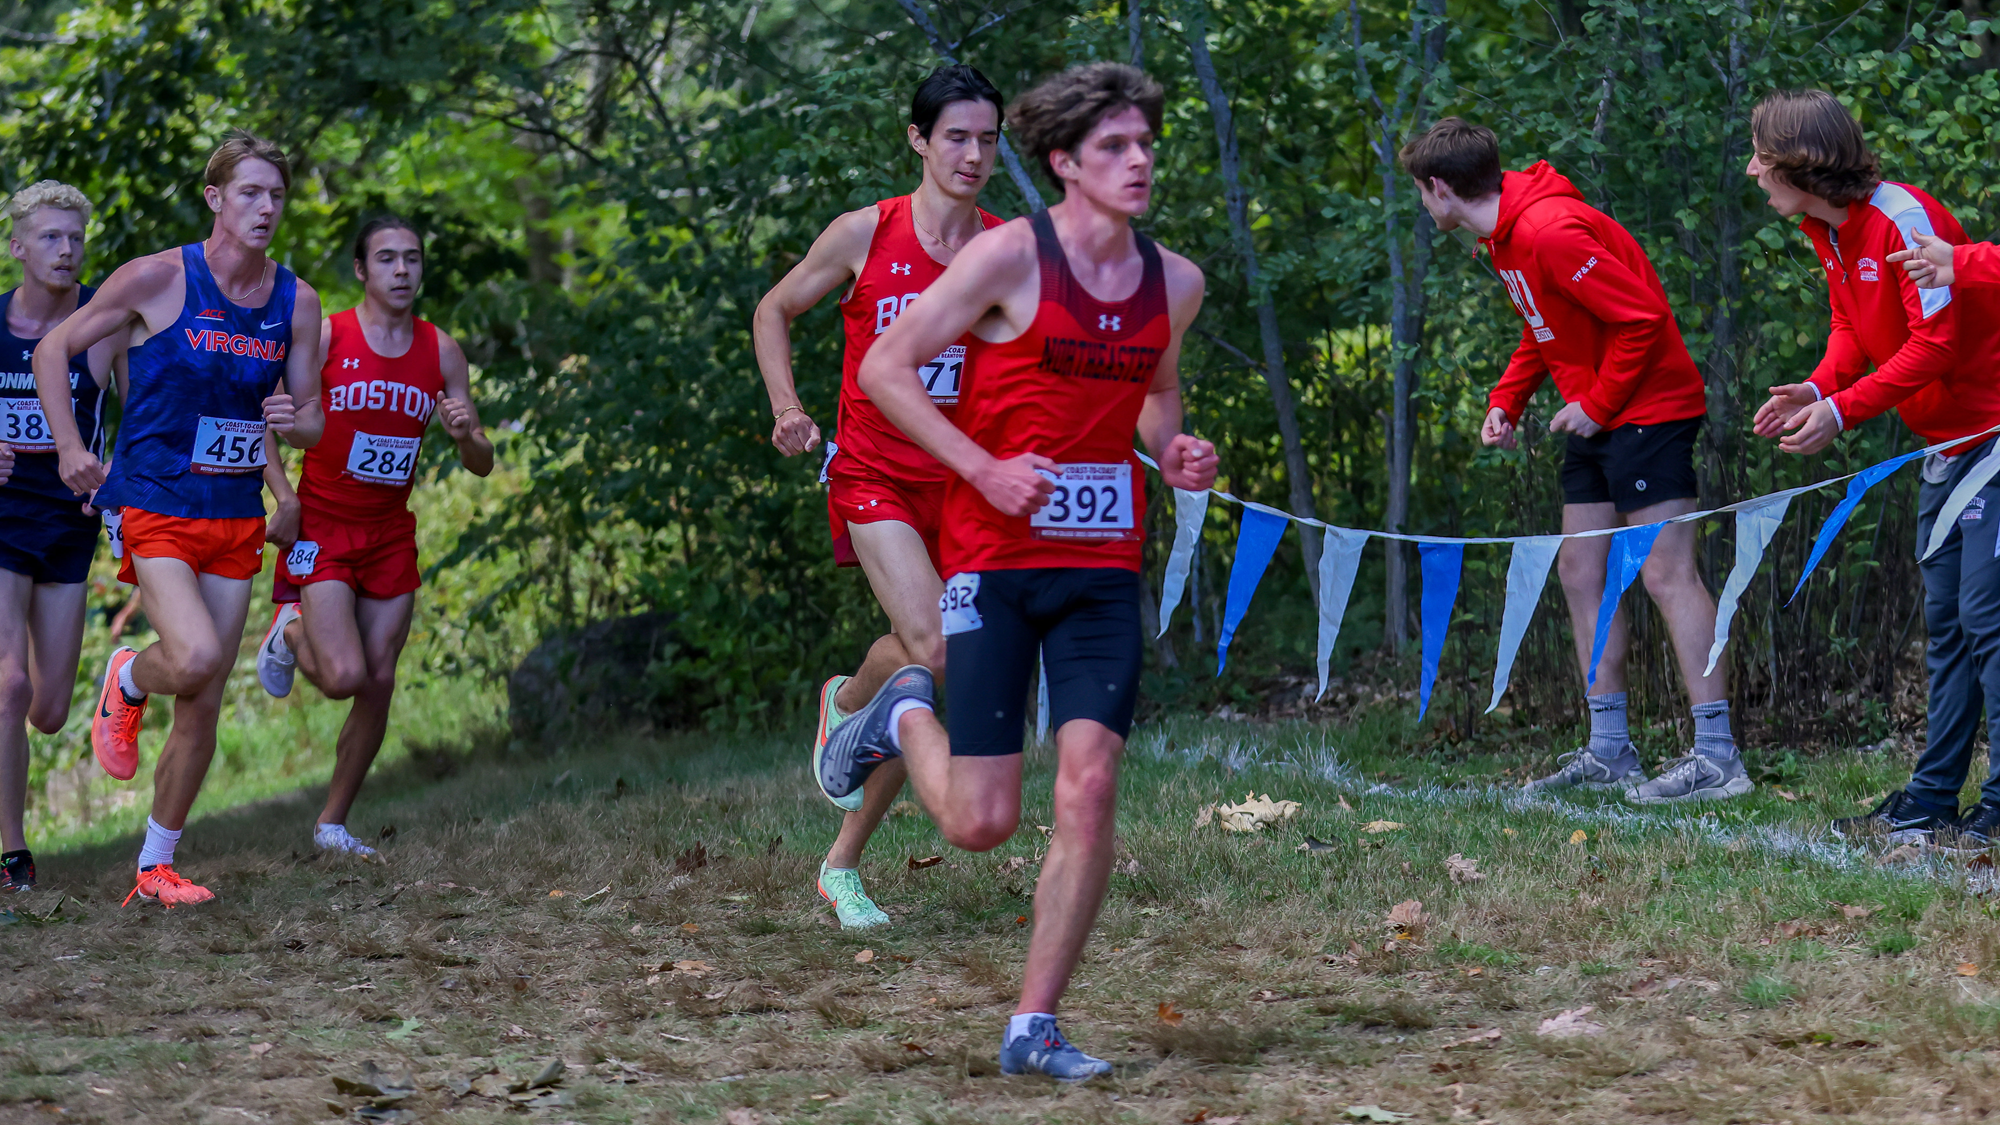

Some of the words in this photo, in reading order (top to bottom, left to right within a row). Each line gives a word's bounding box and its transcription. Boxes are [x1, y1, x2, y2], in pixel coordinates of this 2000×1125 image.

[198, 308, 227, 319] ACC
[184, 328, 286, 362] VIRGINIA
[924, 361, 963, 391] 71
[329, 380, 436, 425] BOSTON
[6, 413, 54, 440] 38
[205, 434, 263, 464] 456
[357, 447, 412, 477] 284
[1048, 485, 1119, 523] 392
[288, 549, 316, 565] 284
